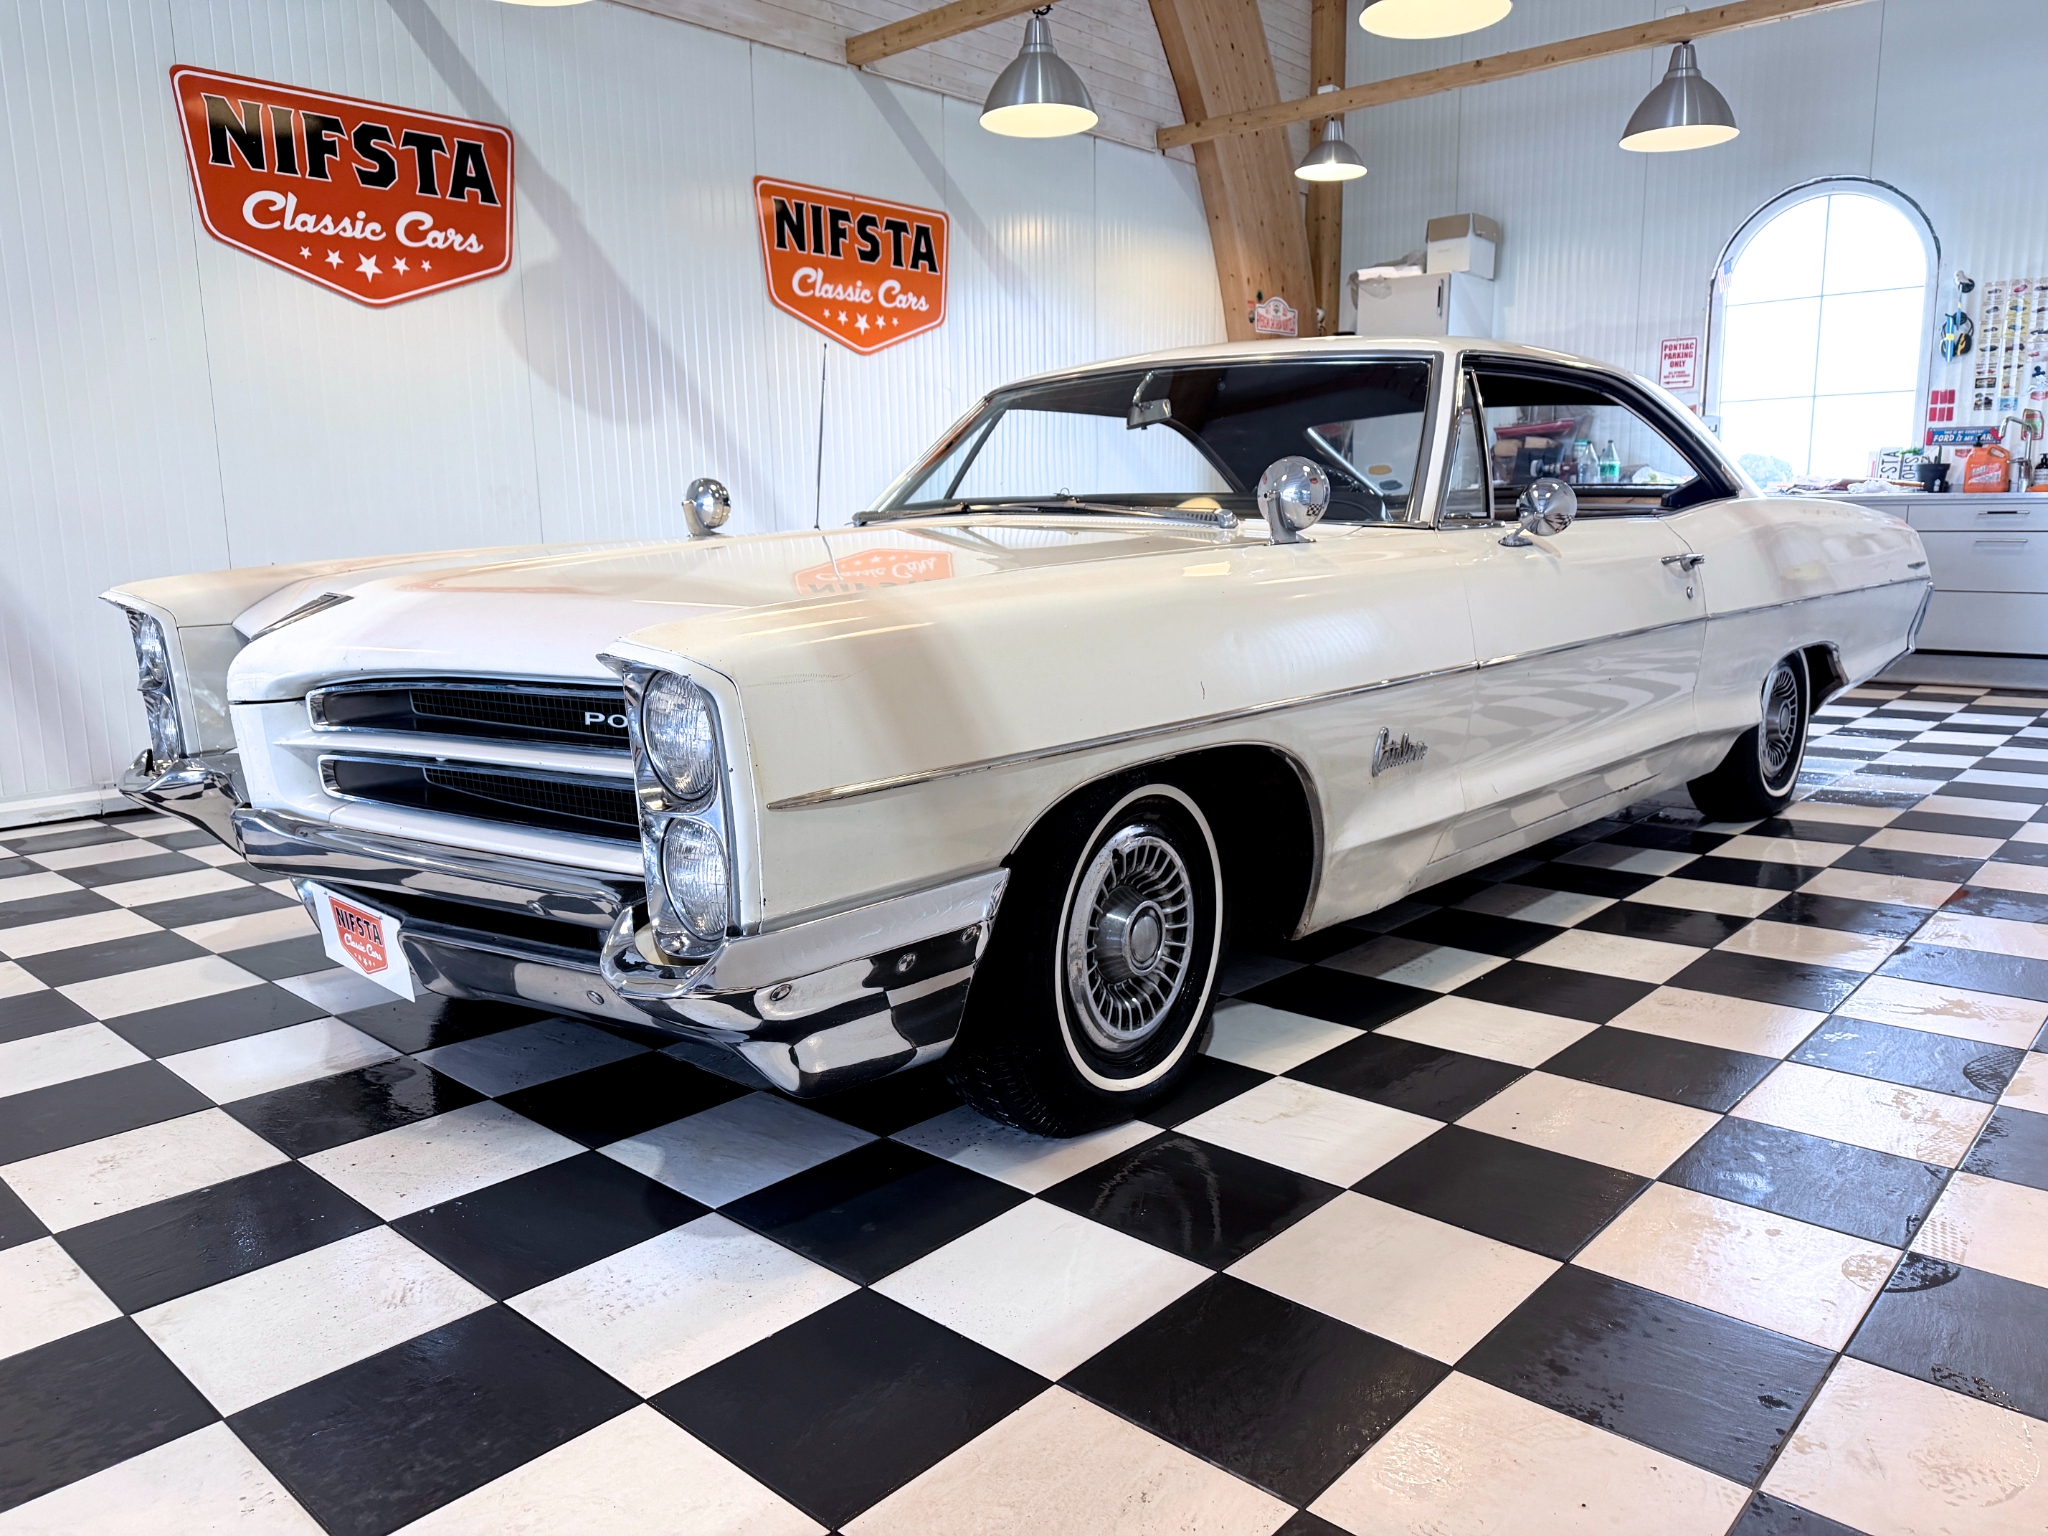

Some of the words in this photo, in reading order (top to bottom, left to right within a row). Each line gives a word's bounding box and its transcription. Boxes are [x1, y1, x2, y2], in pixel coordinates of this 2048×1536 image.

[200, 92, 501, 207] NIFSTA
[242, 190, 386, 241] Classic
[395, 211, 484, 253] Cars
[771, 195, 940, 275] NIFSTA
[792, 267, 873, 304] Classic
[878, 279, 929, 311] Cars
[1664, 342, 1694, 351] PONTIAC
[1664, 351, 1693, 360] PARKING
[1669, 360, 1686, 368] ONLY
[1933, 434, 1955, 442] FORD
[1880, 450, 1900, 479] STA
[335, 906, 383, 946] NIFSTA
[344, 933, 366, 953] Classic
[366, 944, 382, 961] Cars
